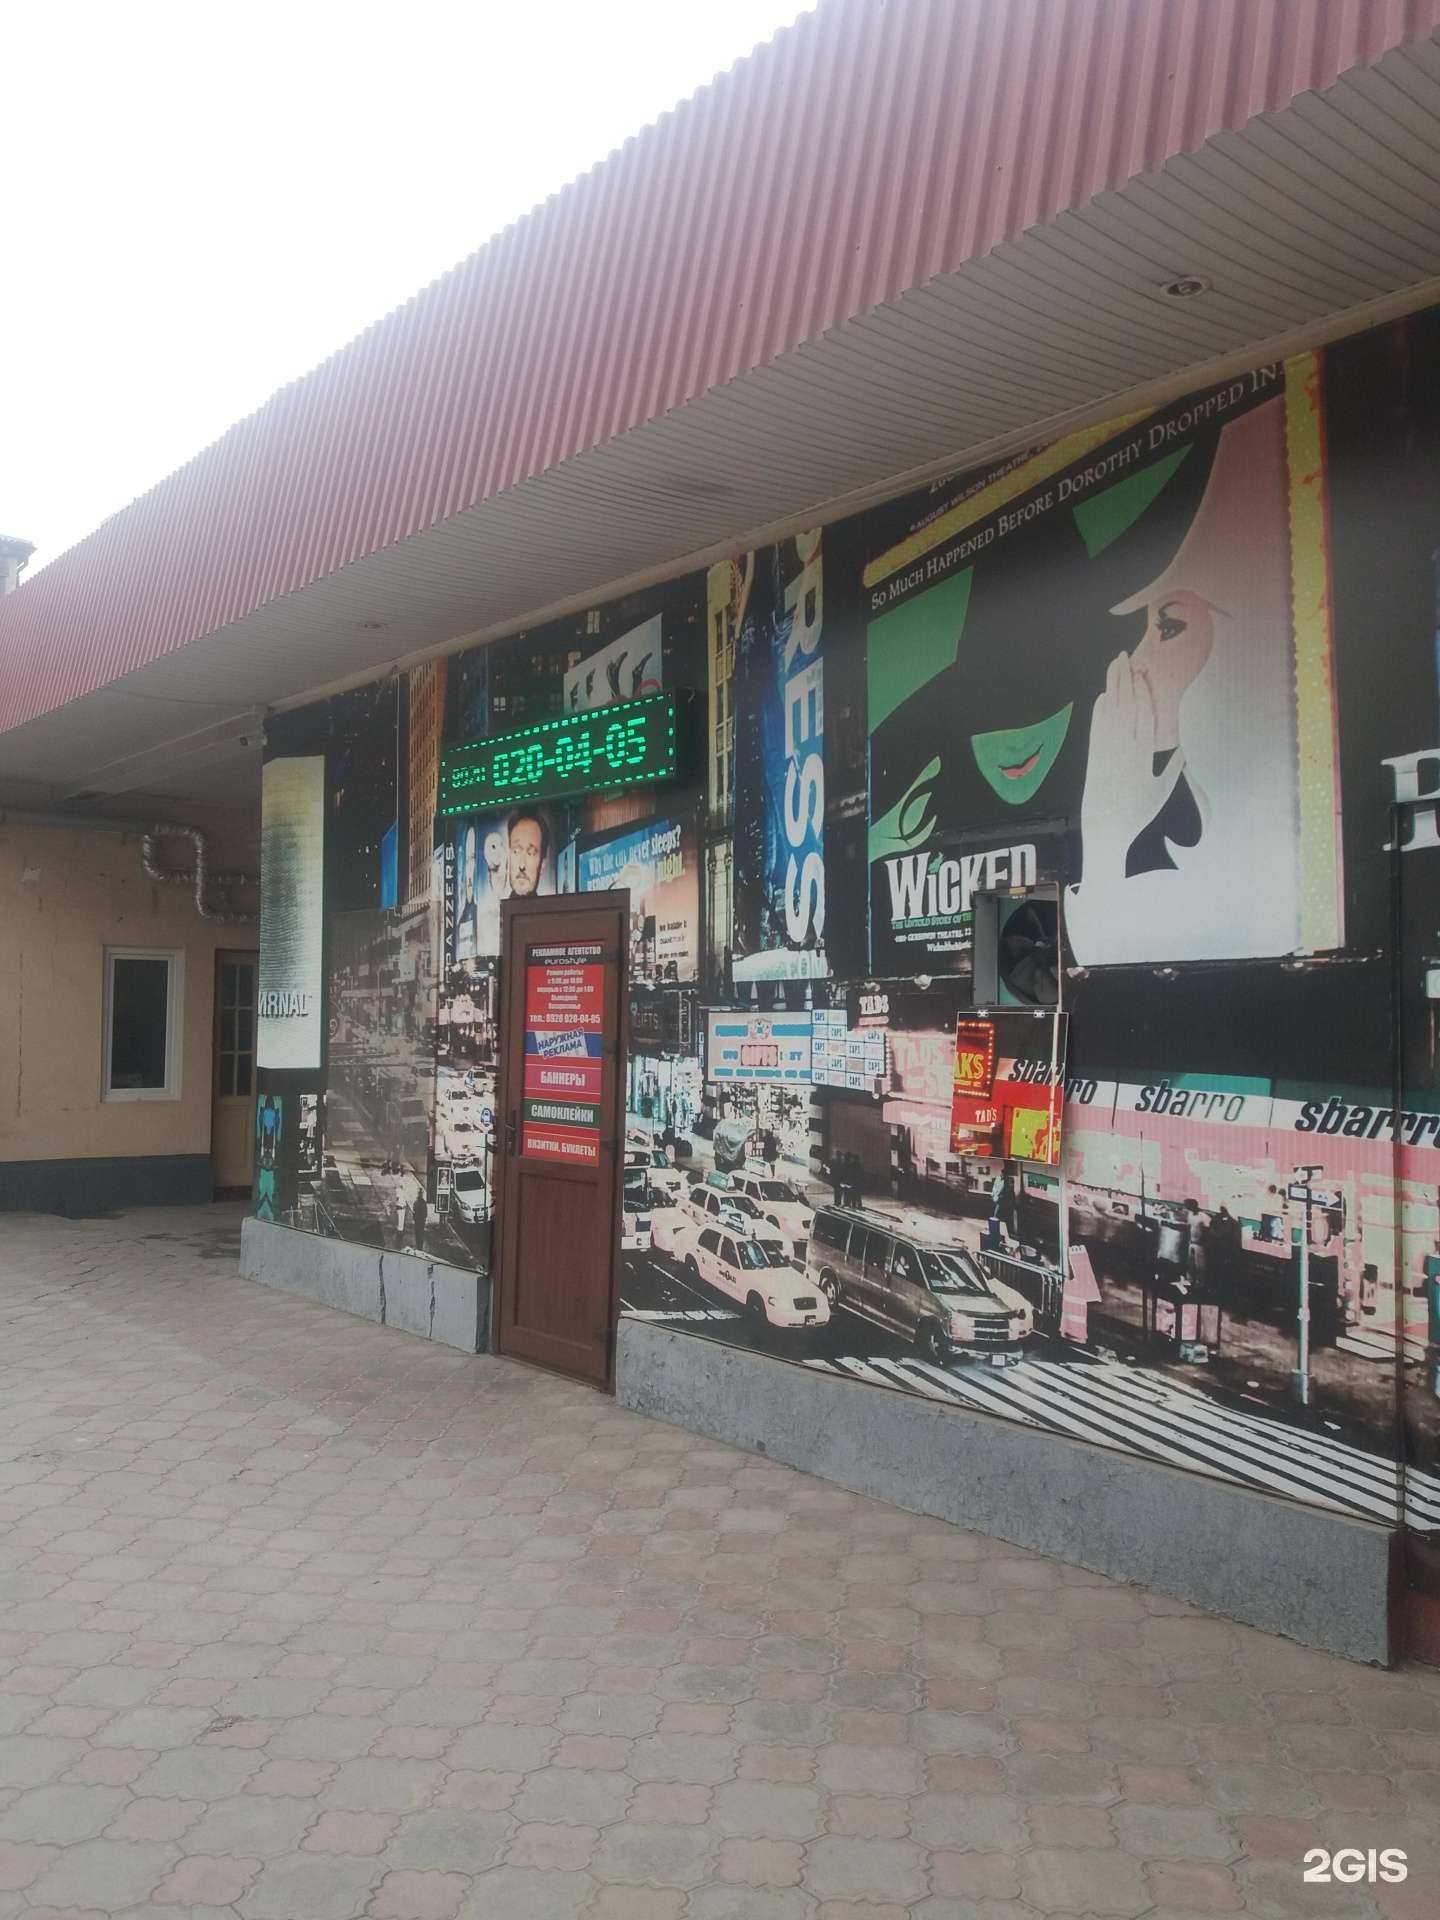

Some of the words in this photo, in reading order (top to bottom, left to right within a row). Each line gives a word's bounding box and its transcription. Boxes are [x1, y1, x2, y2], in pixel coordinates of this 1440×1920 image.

[493, 716, 647, 787] 020-04-05
[538, 1030, 585, 1049] НАРУЖНАЯ
[543, 1040, 582, 1058] РЕКЛАМА
[540, 1071, 585, 1087] БАННЕРЫ
[1134, 1080, 1244, 1122] sbarro
[531, 1105, 594, 1123] САМОКЛЕЙКИ
[561, 1142, 596, 1157] БУКЛЕТЫ
